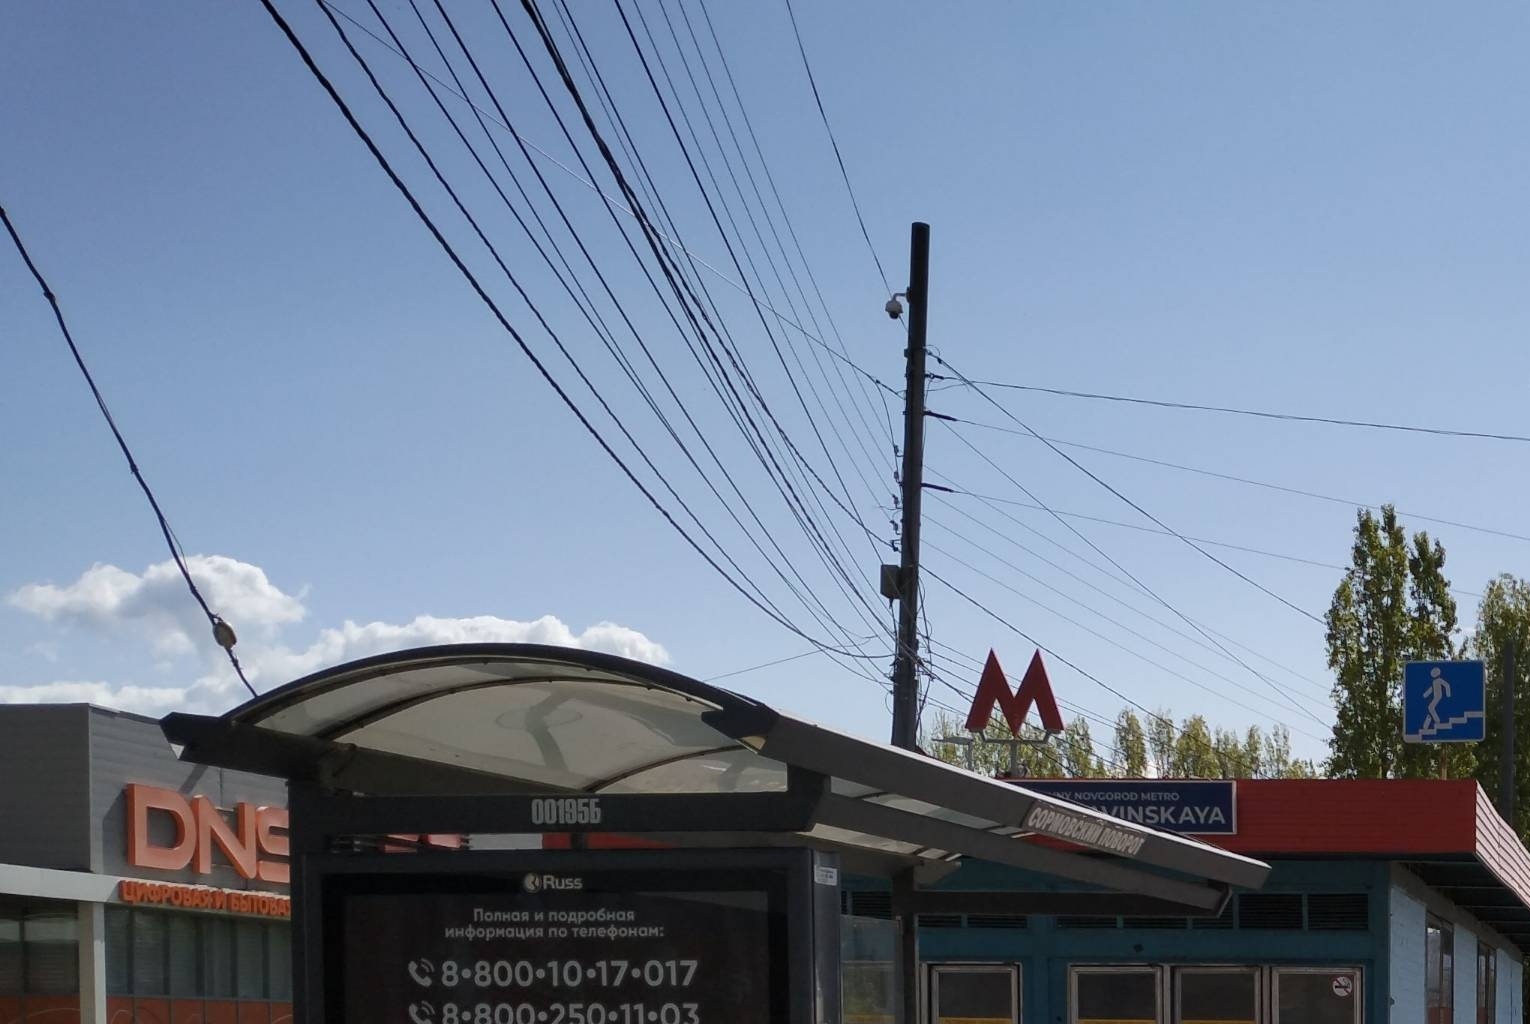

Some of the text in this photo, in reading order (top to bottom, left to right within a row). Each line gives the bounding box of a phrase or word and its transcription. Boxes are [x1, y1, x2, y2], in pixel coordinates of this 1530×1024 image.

[1074, 791, 1138, 801] NOVGOROD
[1140, 791, 1180, 801] METRO
[1092, 805, 1226, 825] VINSKAYA
[1028, 807, 1145, 856] СОРМОВСКИЙ ПОВОРОТ
[542, 874, 583, 890] Russ
[119, 880, 213, 908] ЦИФРОВАЯ
[473, 908, 635, 925] Полная и подробная
[445, 924, 665, 941] информация по телефонам:
